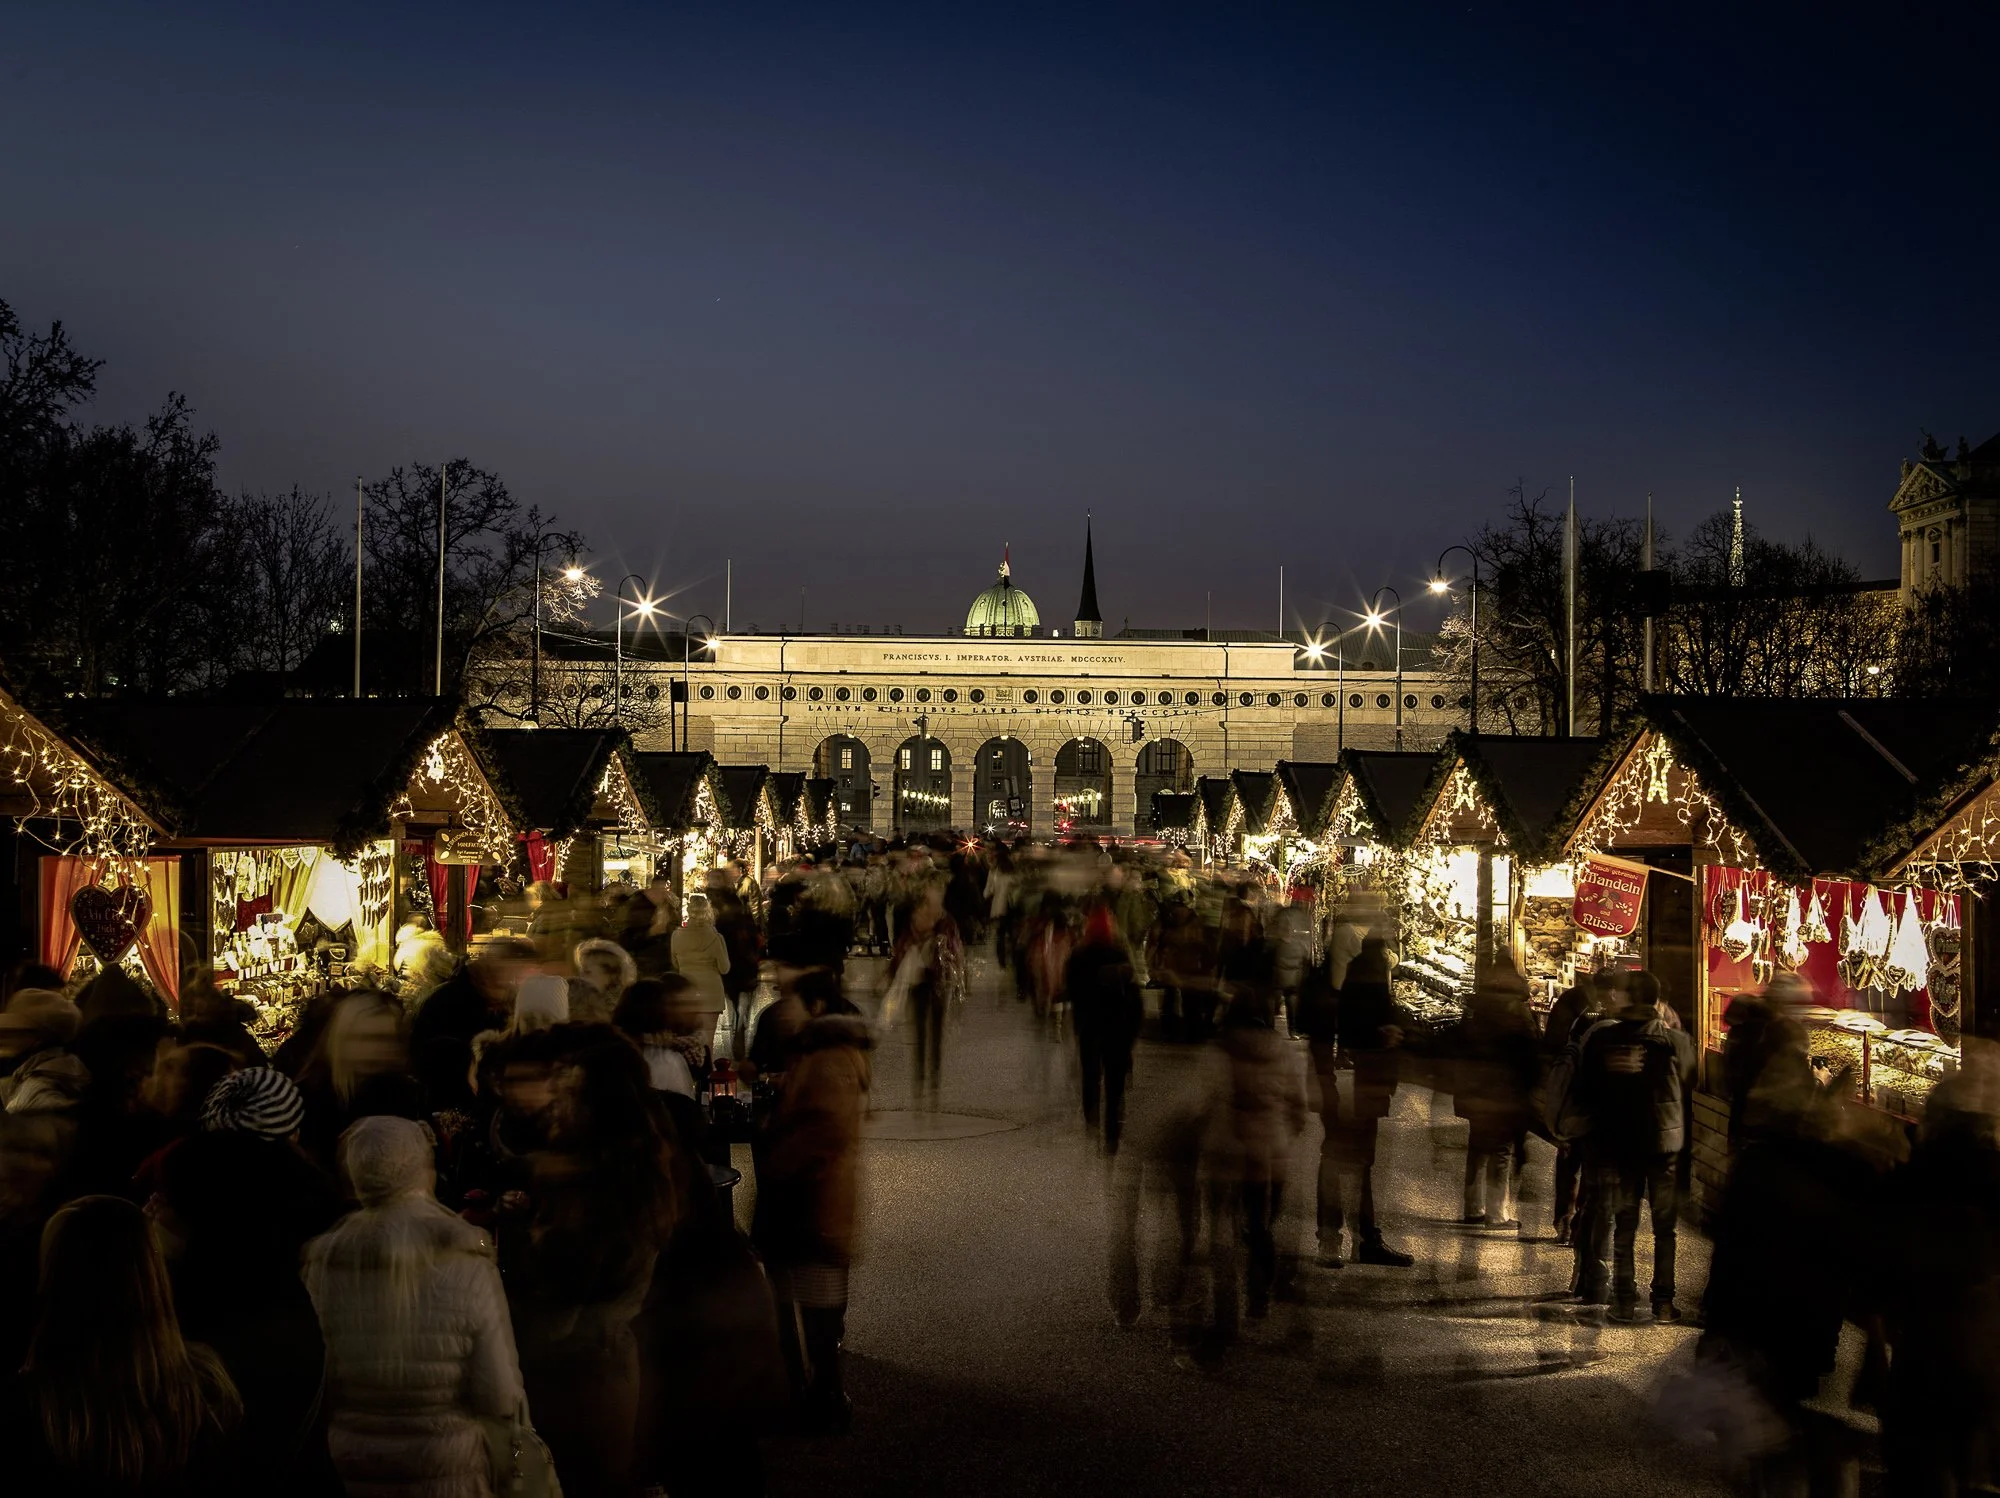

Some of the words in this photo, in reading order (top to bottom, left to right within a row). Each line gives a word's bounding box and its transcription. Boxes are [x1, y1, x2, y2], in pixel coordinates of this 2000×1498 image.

[883, 653, 942, 661] FRANCISCVS.
[1583, 871, 1641, 895] Mandeln
[1581, 913, 1624, 933] Nüsse
